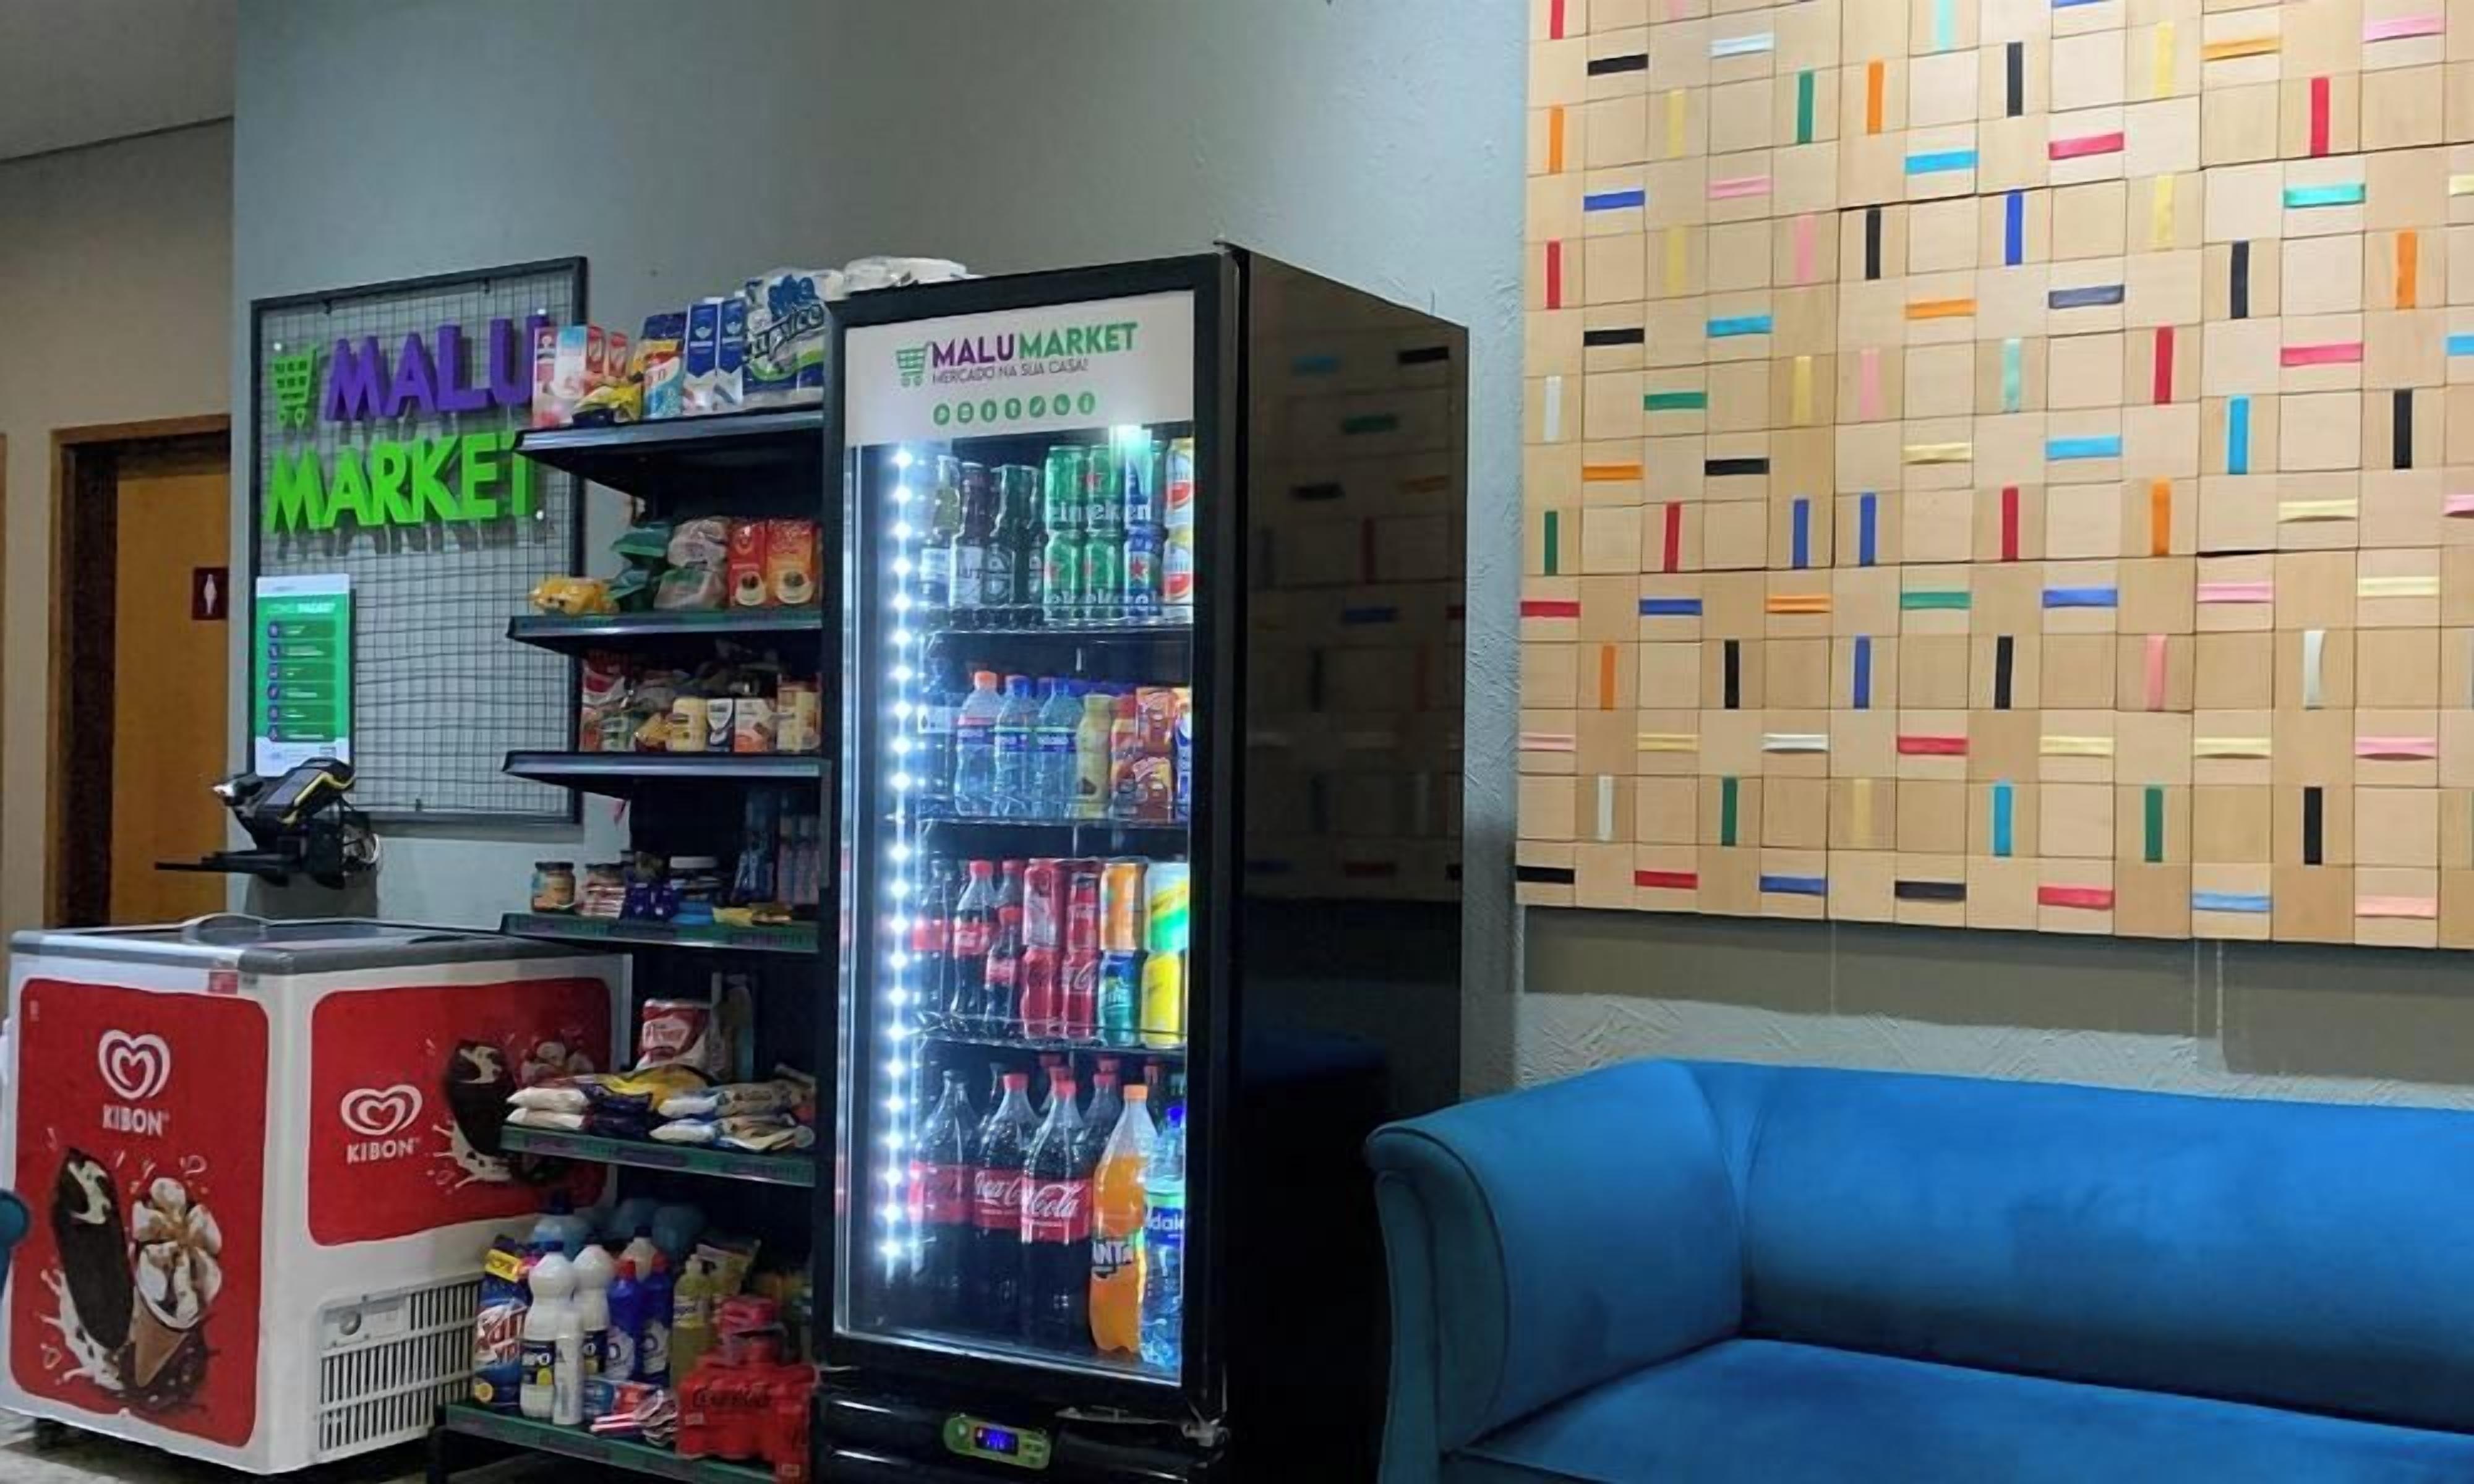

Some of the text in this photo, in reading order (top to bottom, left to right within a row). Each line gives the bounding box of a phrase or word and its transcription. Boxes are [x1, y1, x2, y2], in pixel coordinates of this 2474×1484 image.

[933, 366, 995, 385] MERCADO
[999, 364, 1017, 377] NA
[1021, 362, 1045, 376] SUA
[101, 1103, 163, 1136] KIBON
[346, 1138, 416, 1164] KIBON
